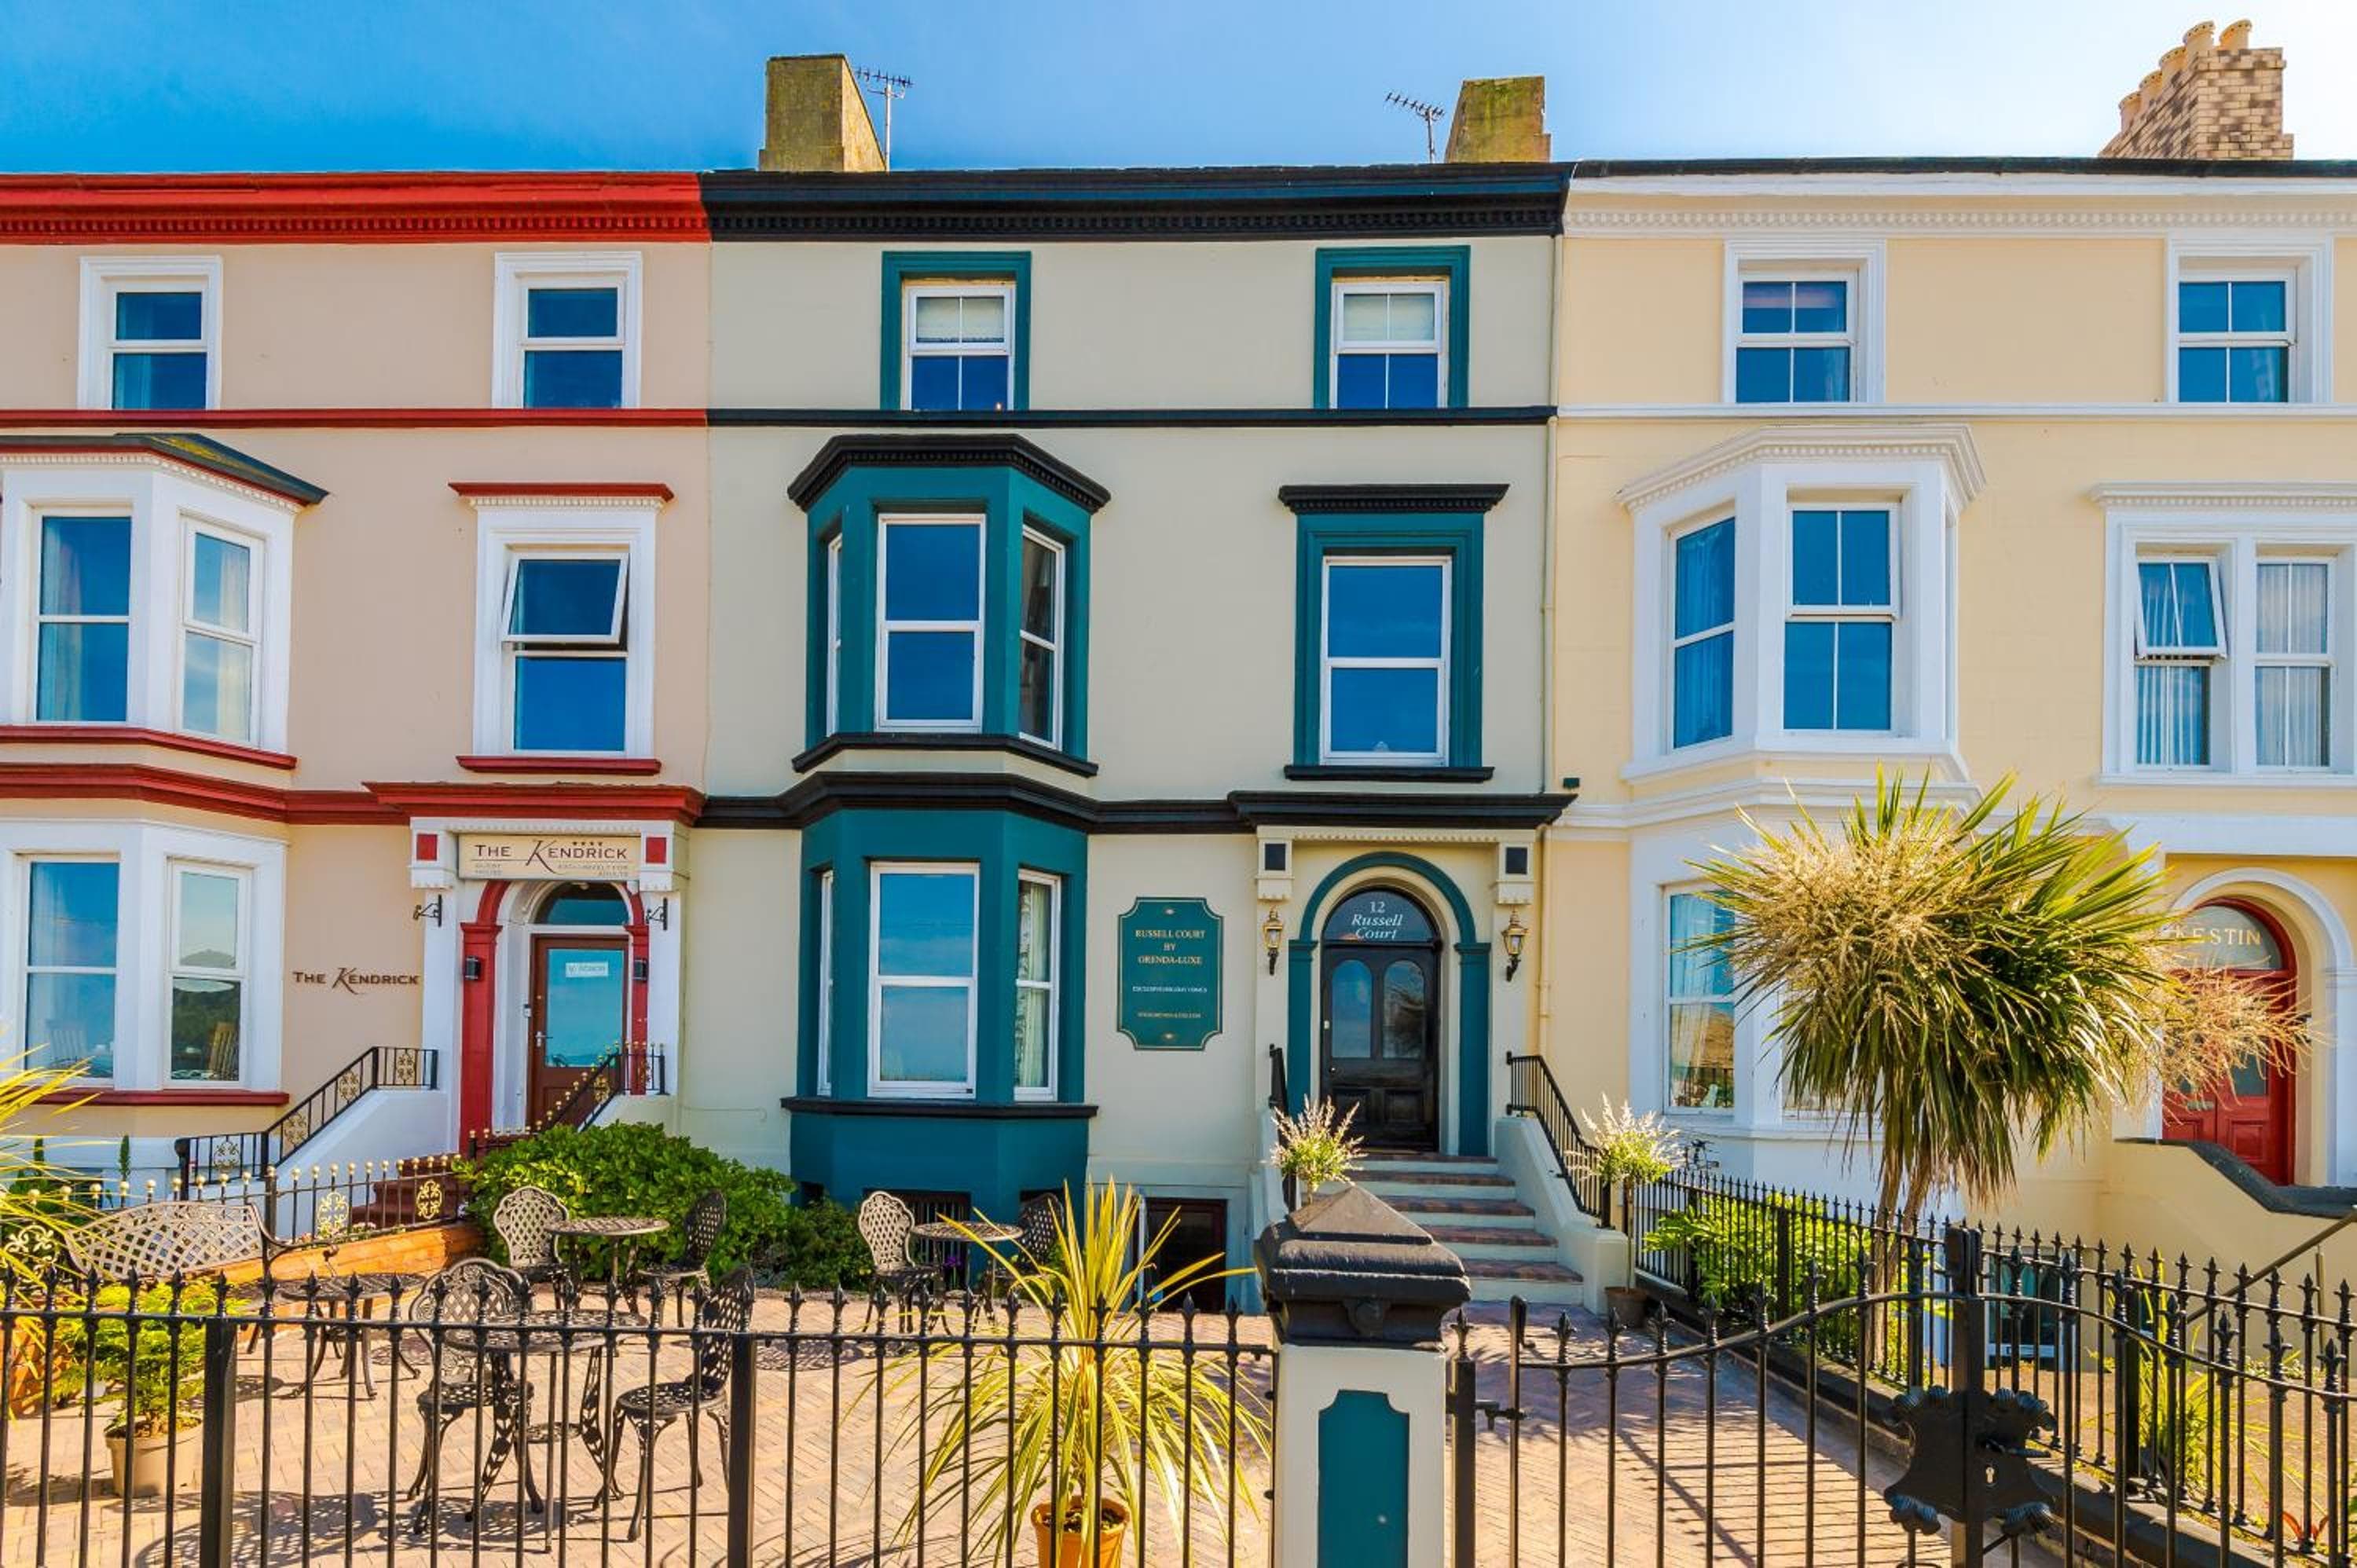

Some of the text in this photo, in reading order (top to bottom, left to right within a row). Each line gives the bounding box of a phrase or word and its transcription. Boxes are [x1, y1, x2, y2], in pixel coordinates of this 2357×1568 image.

[475, 839, 628, 875] THE KENDRICK
[1369, 901, 1386, 914] 12
[1351, 914, 1403, 926] Russell
[1135, 929, 1206, 939] RUSSELL COURT
[1355, 927, 1397, 940] Court
[1164, 942, 1176, 951] BY
[293, 967, 420, 995] THE KENDRICK
